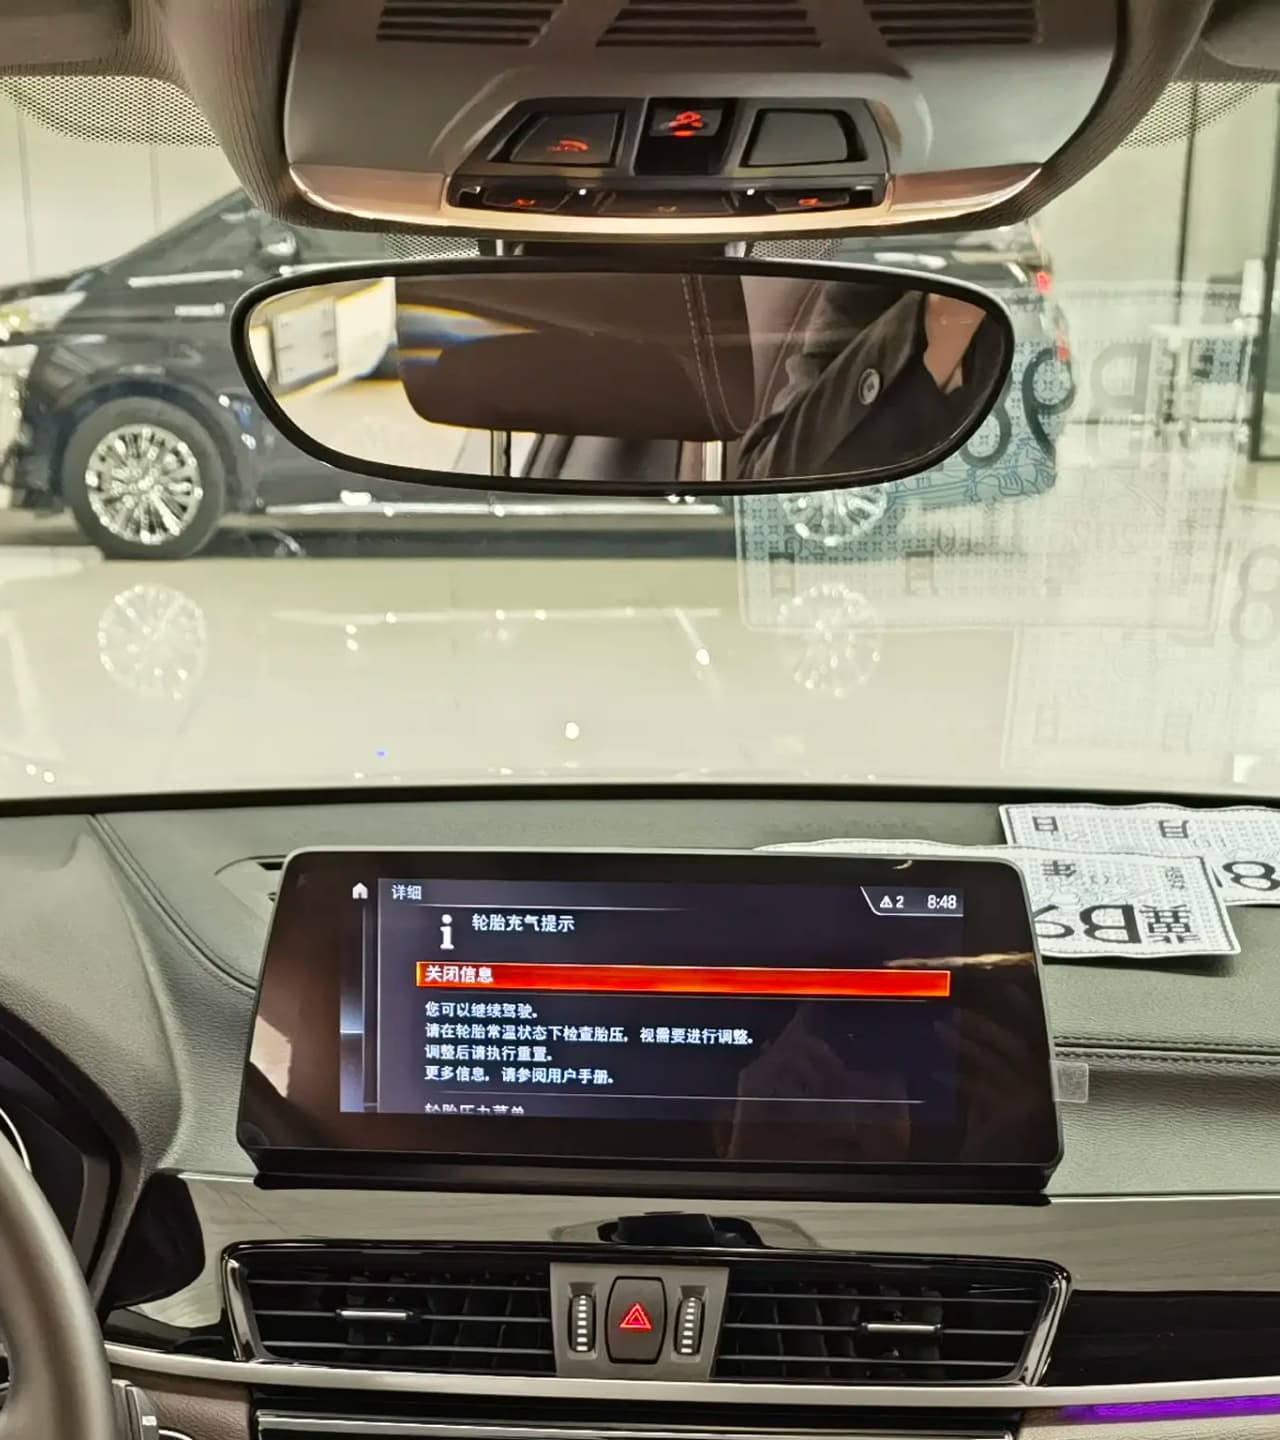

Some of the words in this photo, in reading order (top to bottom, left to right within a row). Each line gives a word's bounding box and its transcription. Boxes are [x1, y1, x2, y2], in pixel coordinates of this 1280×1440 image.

[1158, 819, 1190, 839] 月
[391, 884, 423, 901] 详细
[895, 895, 905, 909] 2
[927, 894, 958, 910] 8:48
[471, 913, 576, 933] 轮胎充气提示
[424, 964, 495, 984] 关闭信息
[424, 1001, 539, 1019] 您可以继续驾驶。
[424, 1044, 553, 1062] 调整后请执行重置。
